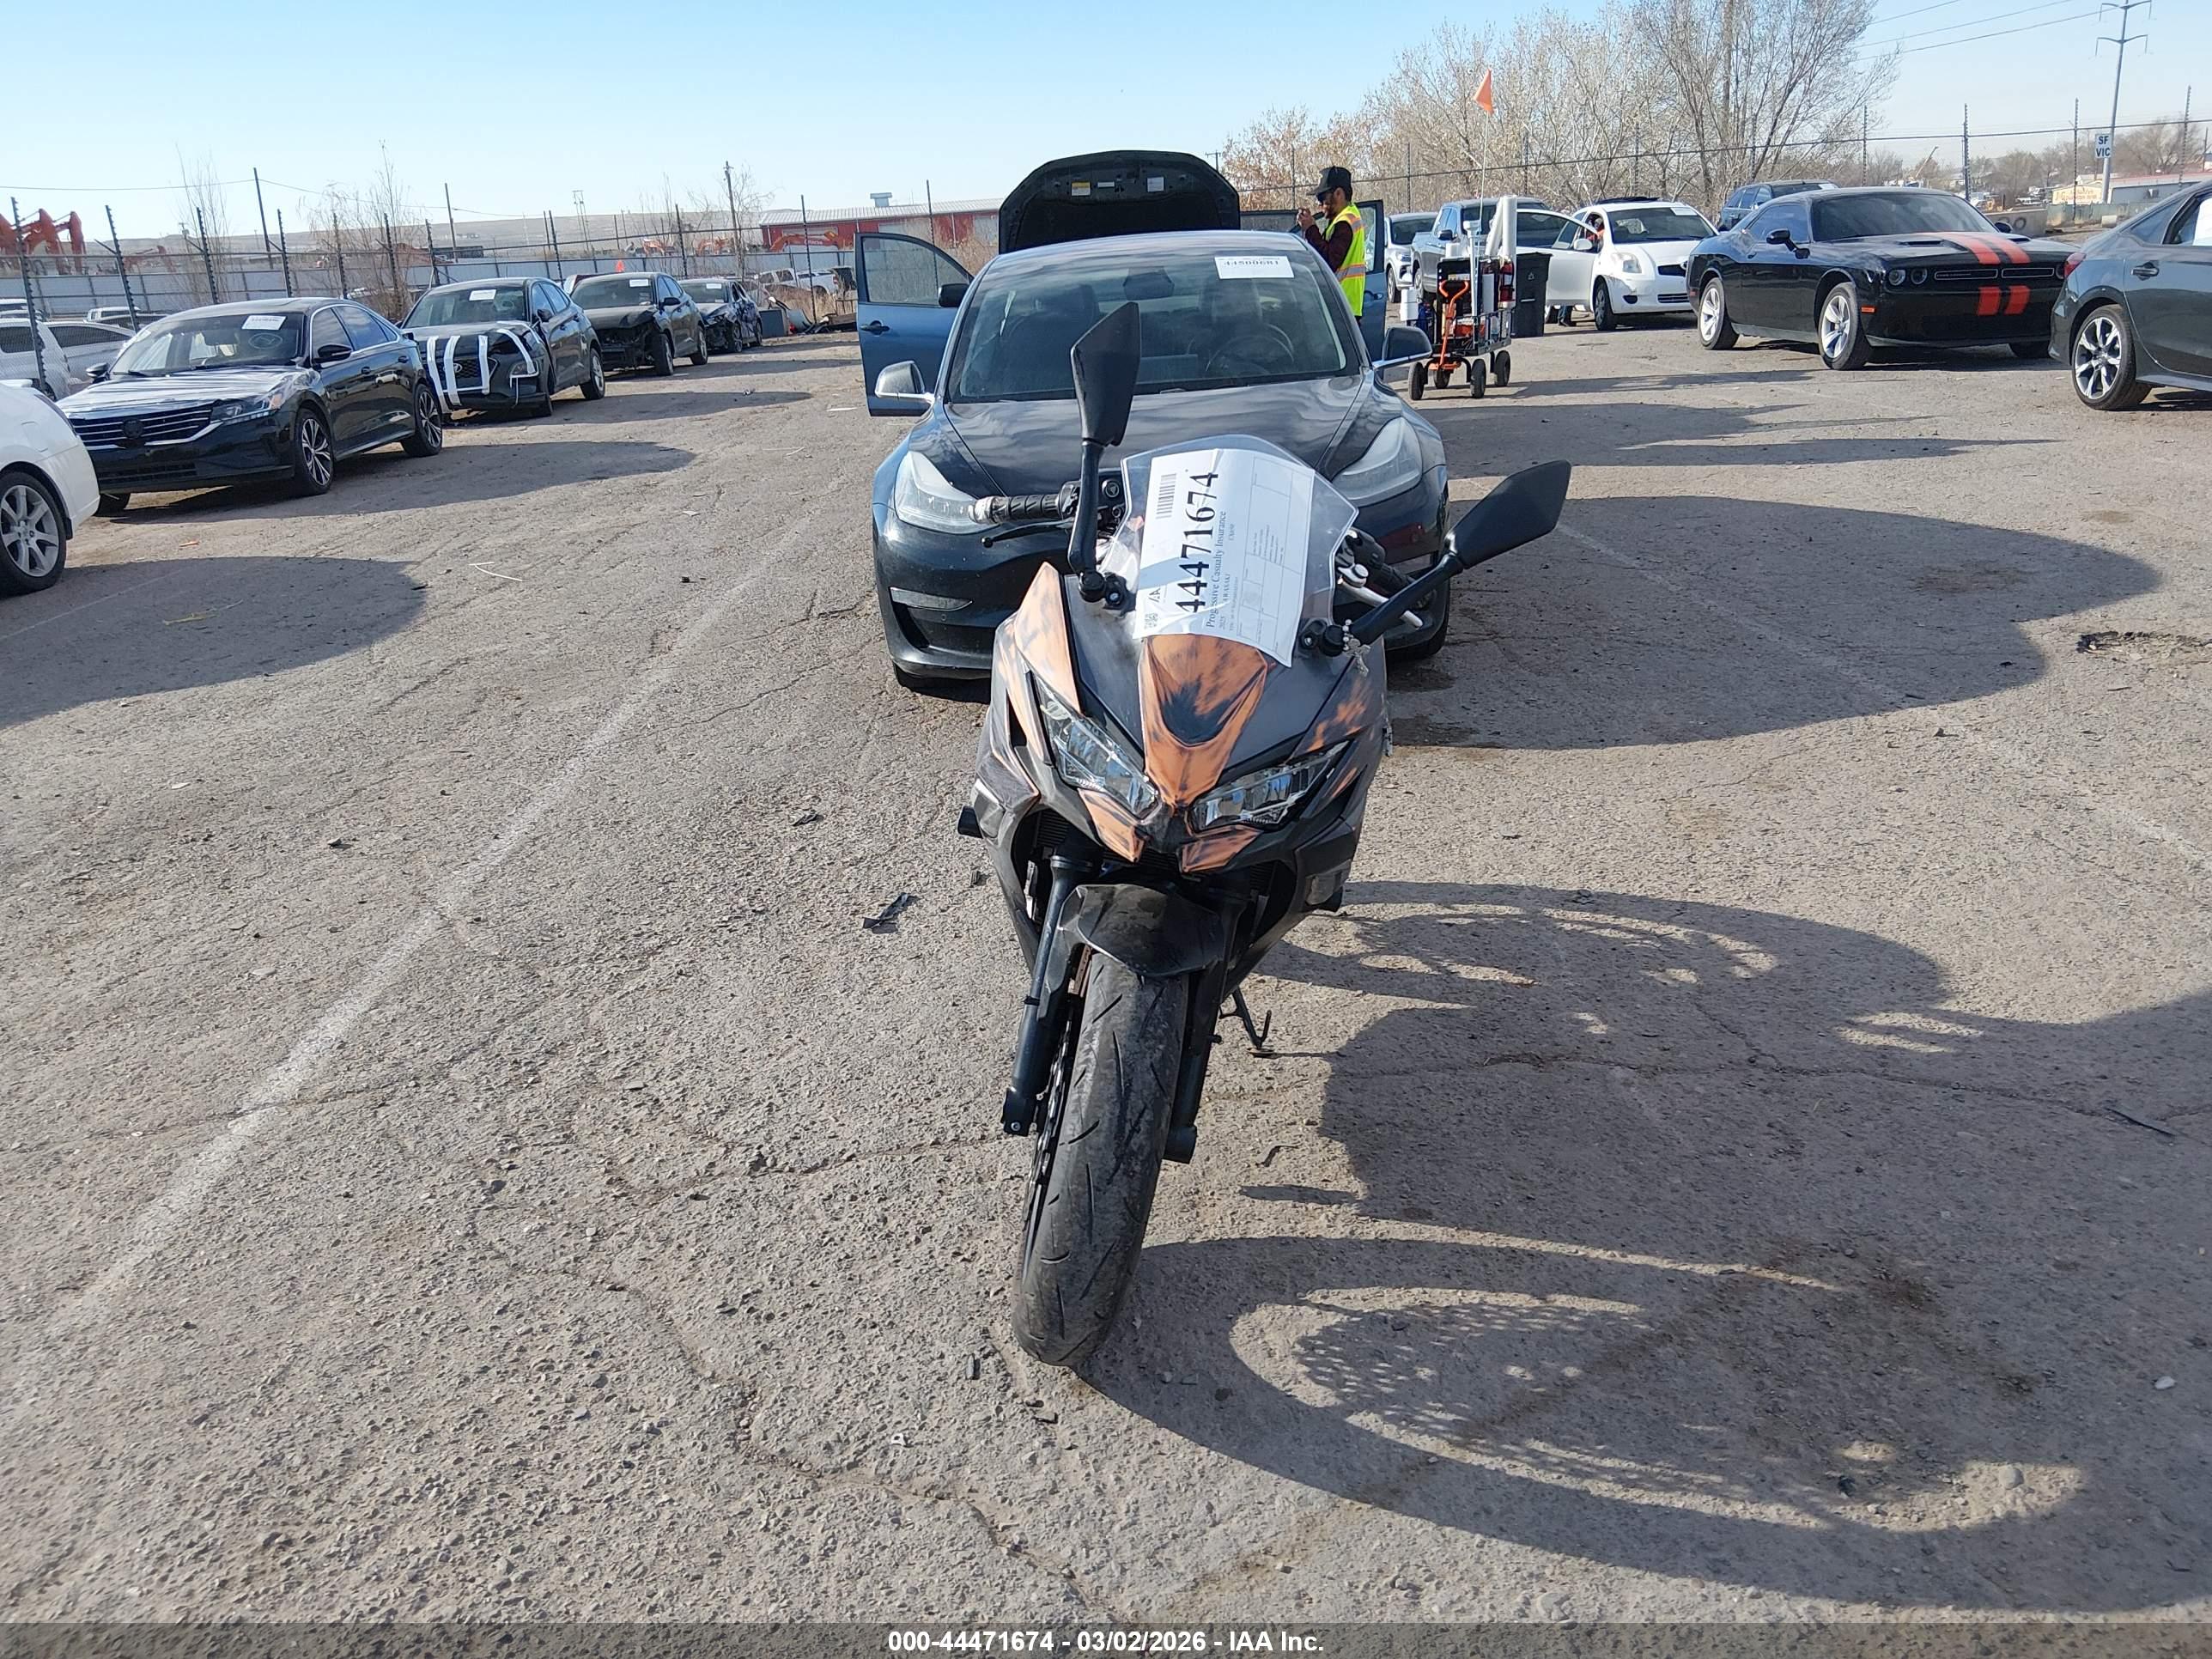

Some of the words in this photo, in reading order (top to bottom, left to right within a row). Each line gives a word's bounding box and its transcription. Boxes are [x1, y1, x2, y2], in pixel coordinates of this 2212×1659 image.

[2096, 148, 2111, 157] VIC
[2098, 135, 2109, 145] SF
[1175, 472, 1218, 613] 44471674
[1215, 511, 1226, 547] Insurance
[1211, 550, 1224, 582] Casualty
